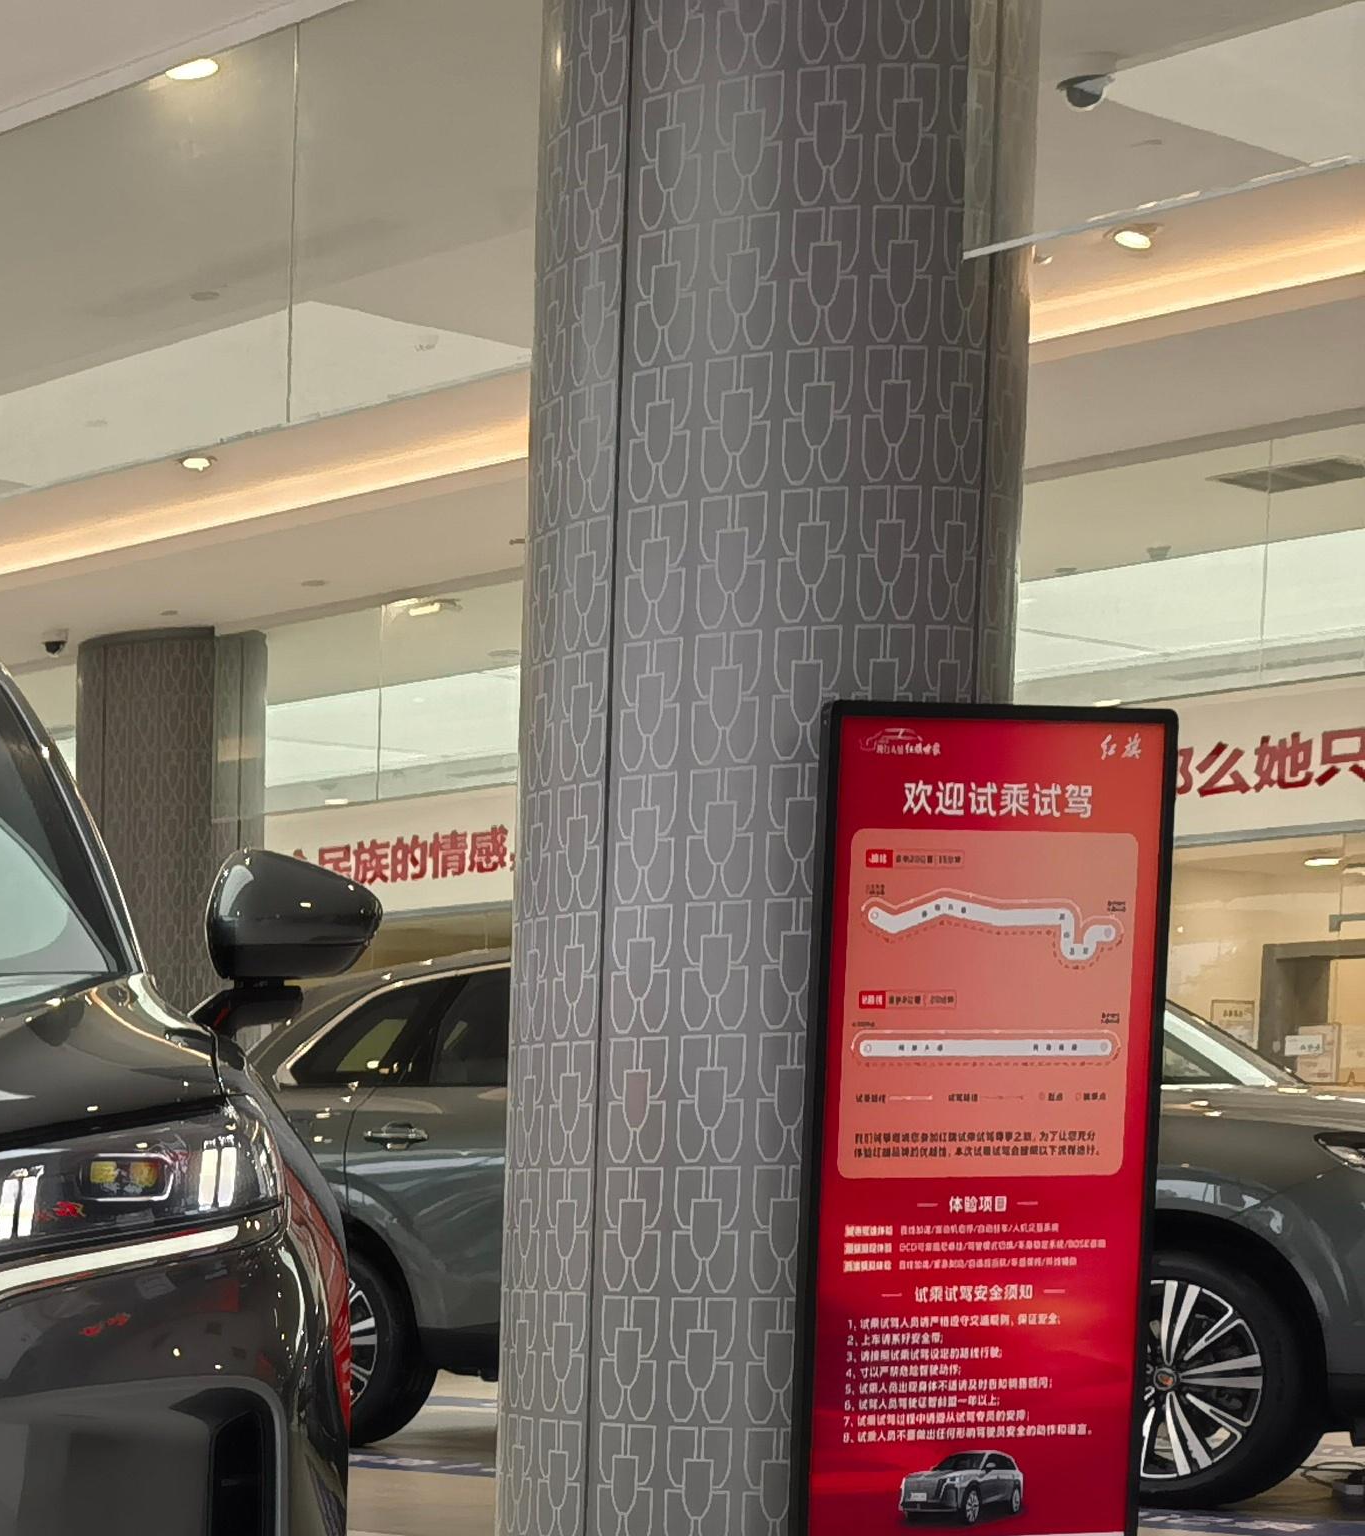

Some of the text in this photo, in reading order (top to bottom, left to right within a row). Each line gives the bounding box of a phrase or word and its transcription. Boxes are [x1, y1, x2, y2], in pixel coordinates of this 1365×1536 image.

[1100, 732, 1142, 761] 红旗
[902, 780, 1093, 818] 欢迎试乘试驾
[293, 824, 516, 885] 民族的情感
[949, 1196, 1007, 1213] 体验项目
[914, 1284, 1033, 1303] 试乘试驾安全须知
